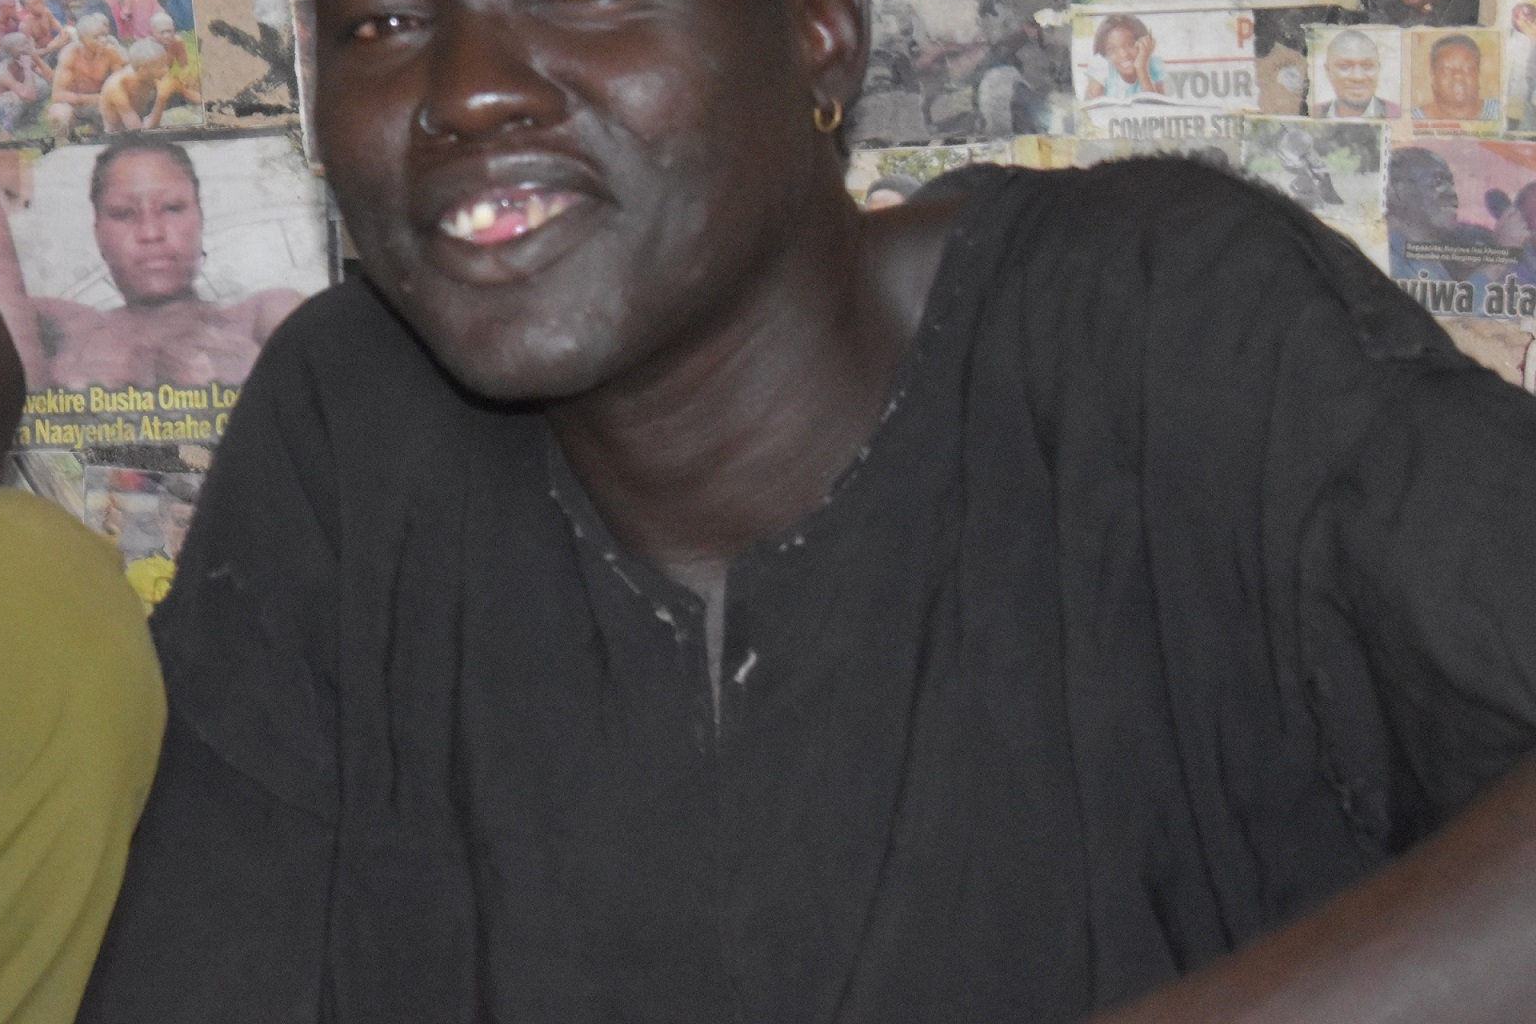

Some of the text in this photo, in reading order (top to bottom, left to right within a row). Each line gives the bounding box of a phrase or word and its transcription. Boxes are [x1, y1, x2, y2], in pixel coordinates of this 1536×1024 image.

[1236, 17, 1254, 49] P
[1168, 69, 1252, 99] YOUR
[1108, 114, 1206, 139] COMPUTER
[89, 386, 155, 413] Busha
[158, 383, 208, 410] Omu
[212, 382, 242, 408] Lo
[35, 416, 135, 449] Naayenda
[139, 414, 212, 442] Ataahe
